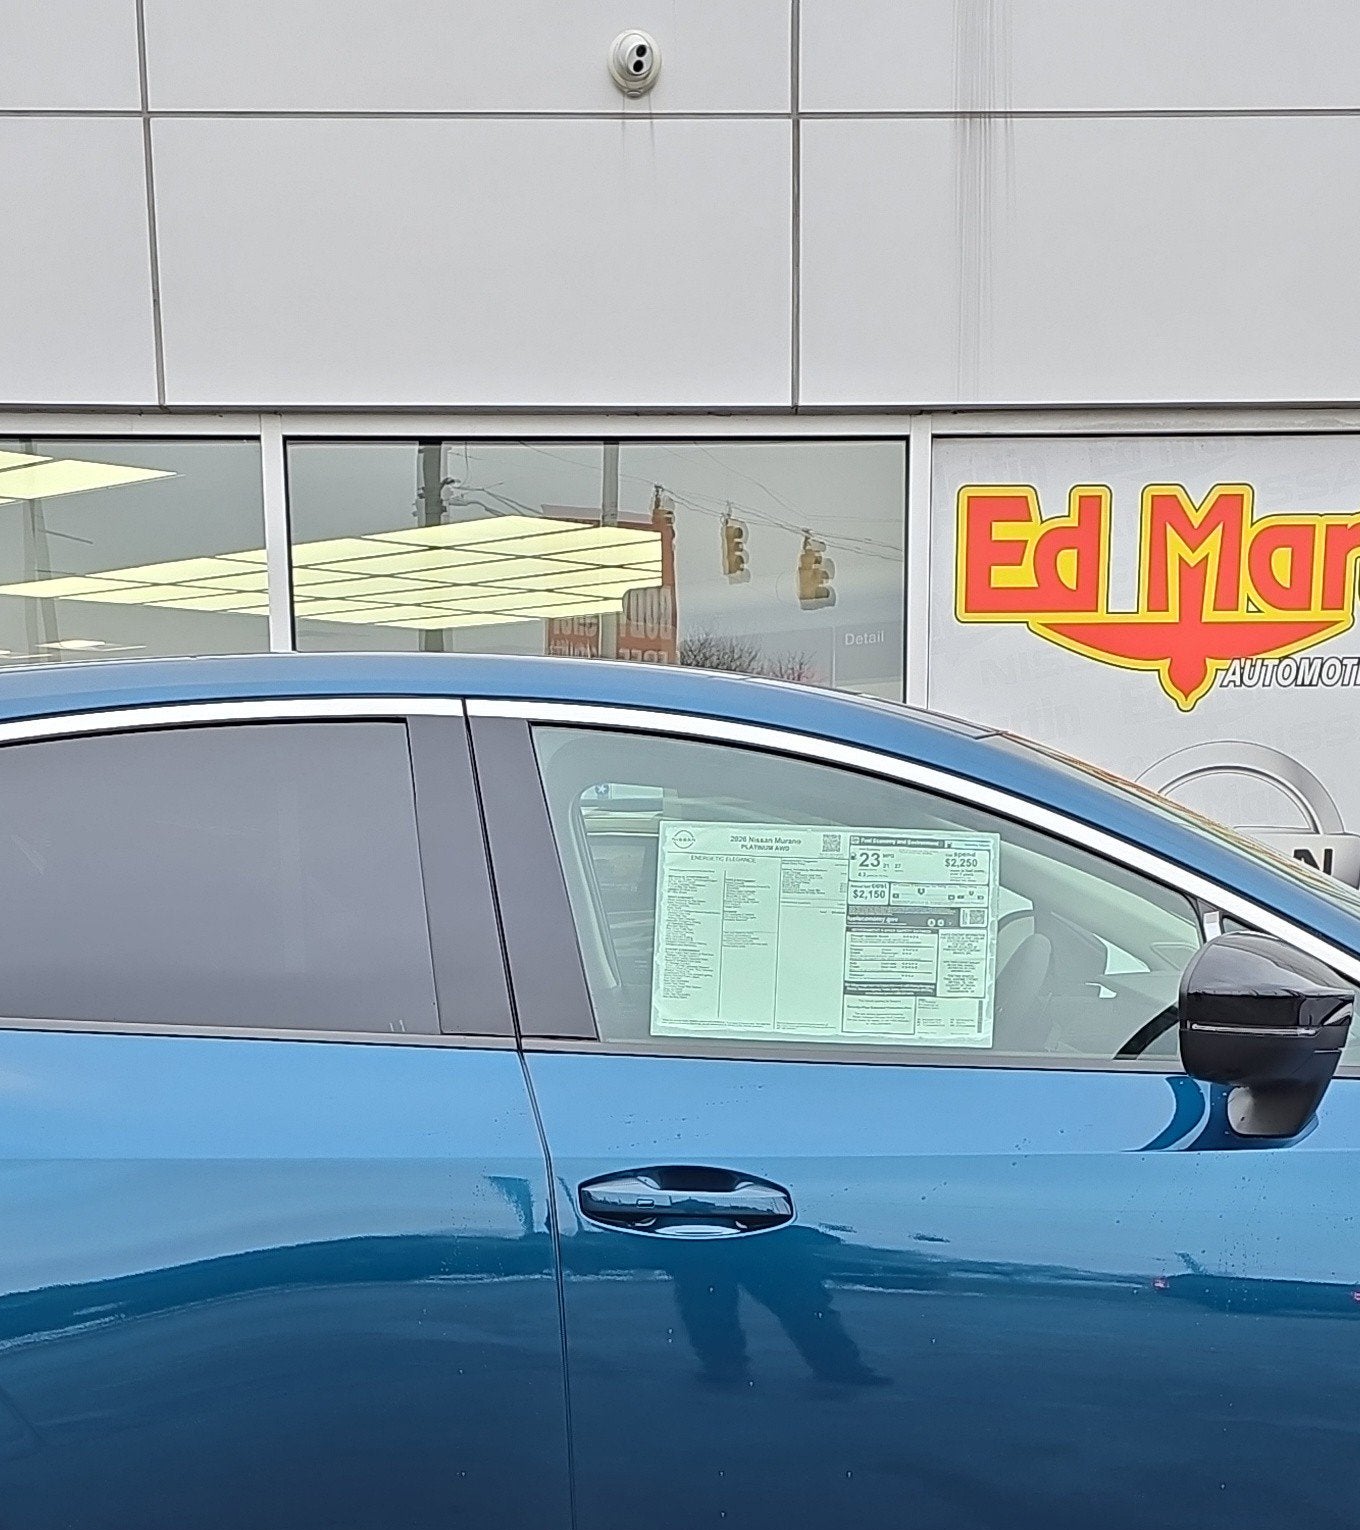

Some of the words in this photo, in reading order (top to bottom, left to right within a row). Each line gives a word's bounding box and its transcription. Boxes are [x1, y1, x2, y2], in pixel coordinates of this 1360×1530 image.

[955, 486, 1112, 622] Ed
[845, 631, 884, 645] Detail
[774, 837, 802, 845] Murano
[859, 852, 881, 868] 23
[945, 858, 978, 868] $2,250
[853, 889, 886, 900] $2,150
